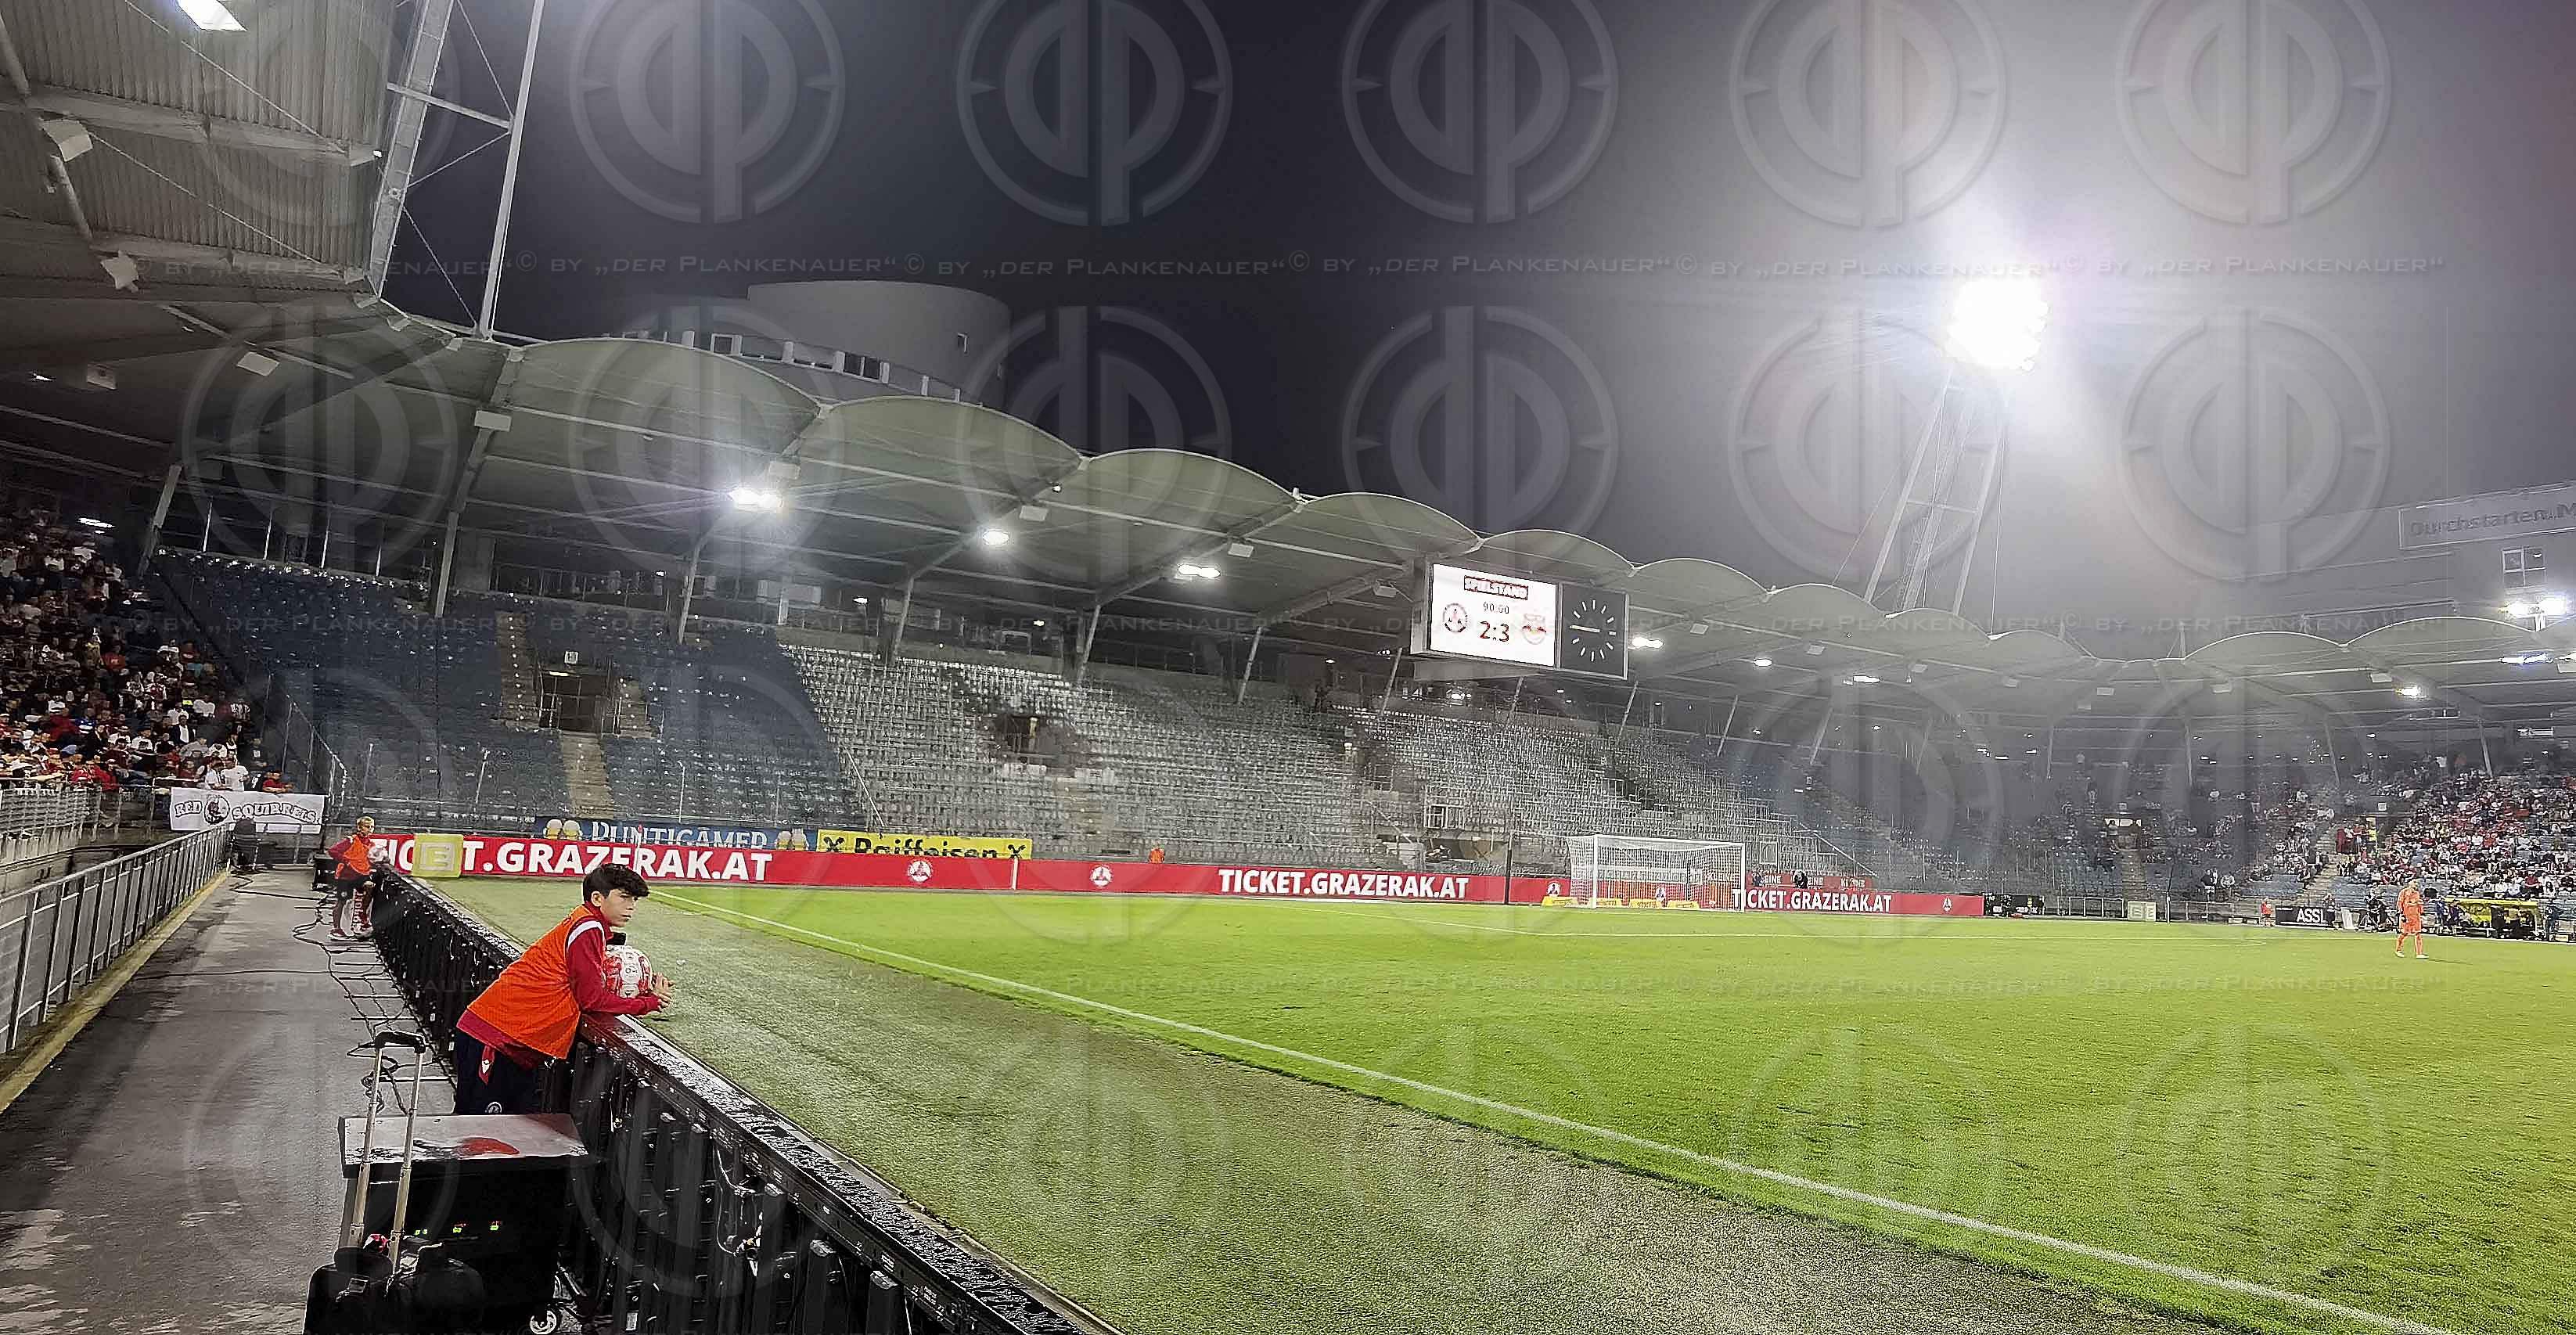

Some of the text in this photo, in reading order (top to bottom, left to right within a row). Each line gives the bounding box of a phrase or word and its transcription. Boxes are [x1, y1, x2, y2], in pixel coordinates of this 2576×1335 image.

[1479, 621, 1509, 642] 2:3
[174, 800, 317, 823] RED SQUIRRELS
[1218, 868, 1470, 899] TICKET.GRAZERAK.AT
[1732, 888, 1893, 913] TICKET.GRAZERAK.AT
